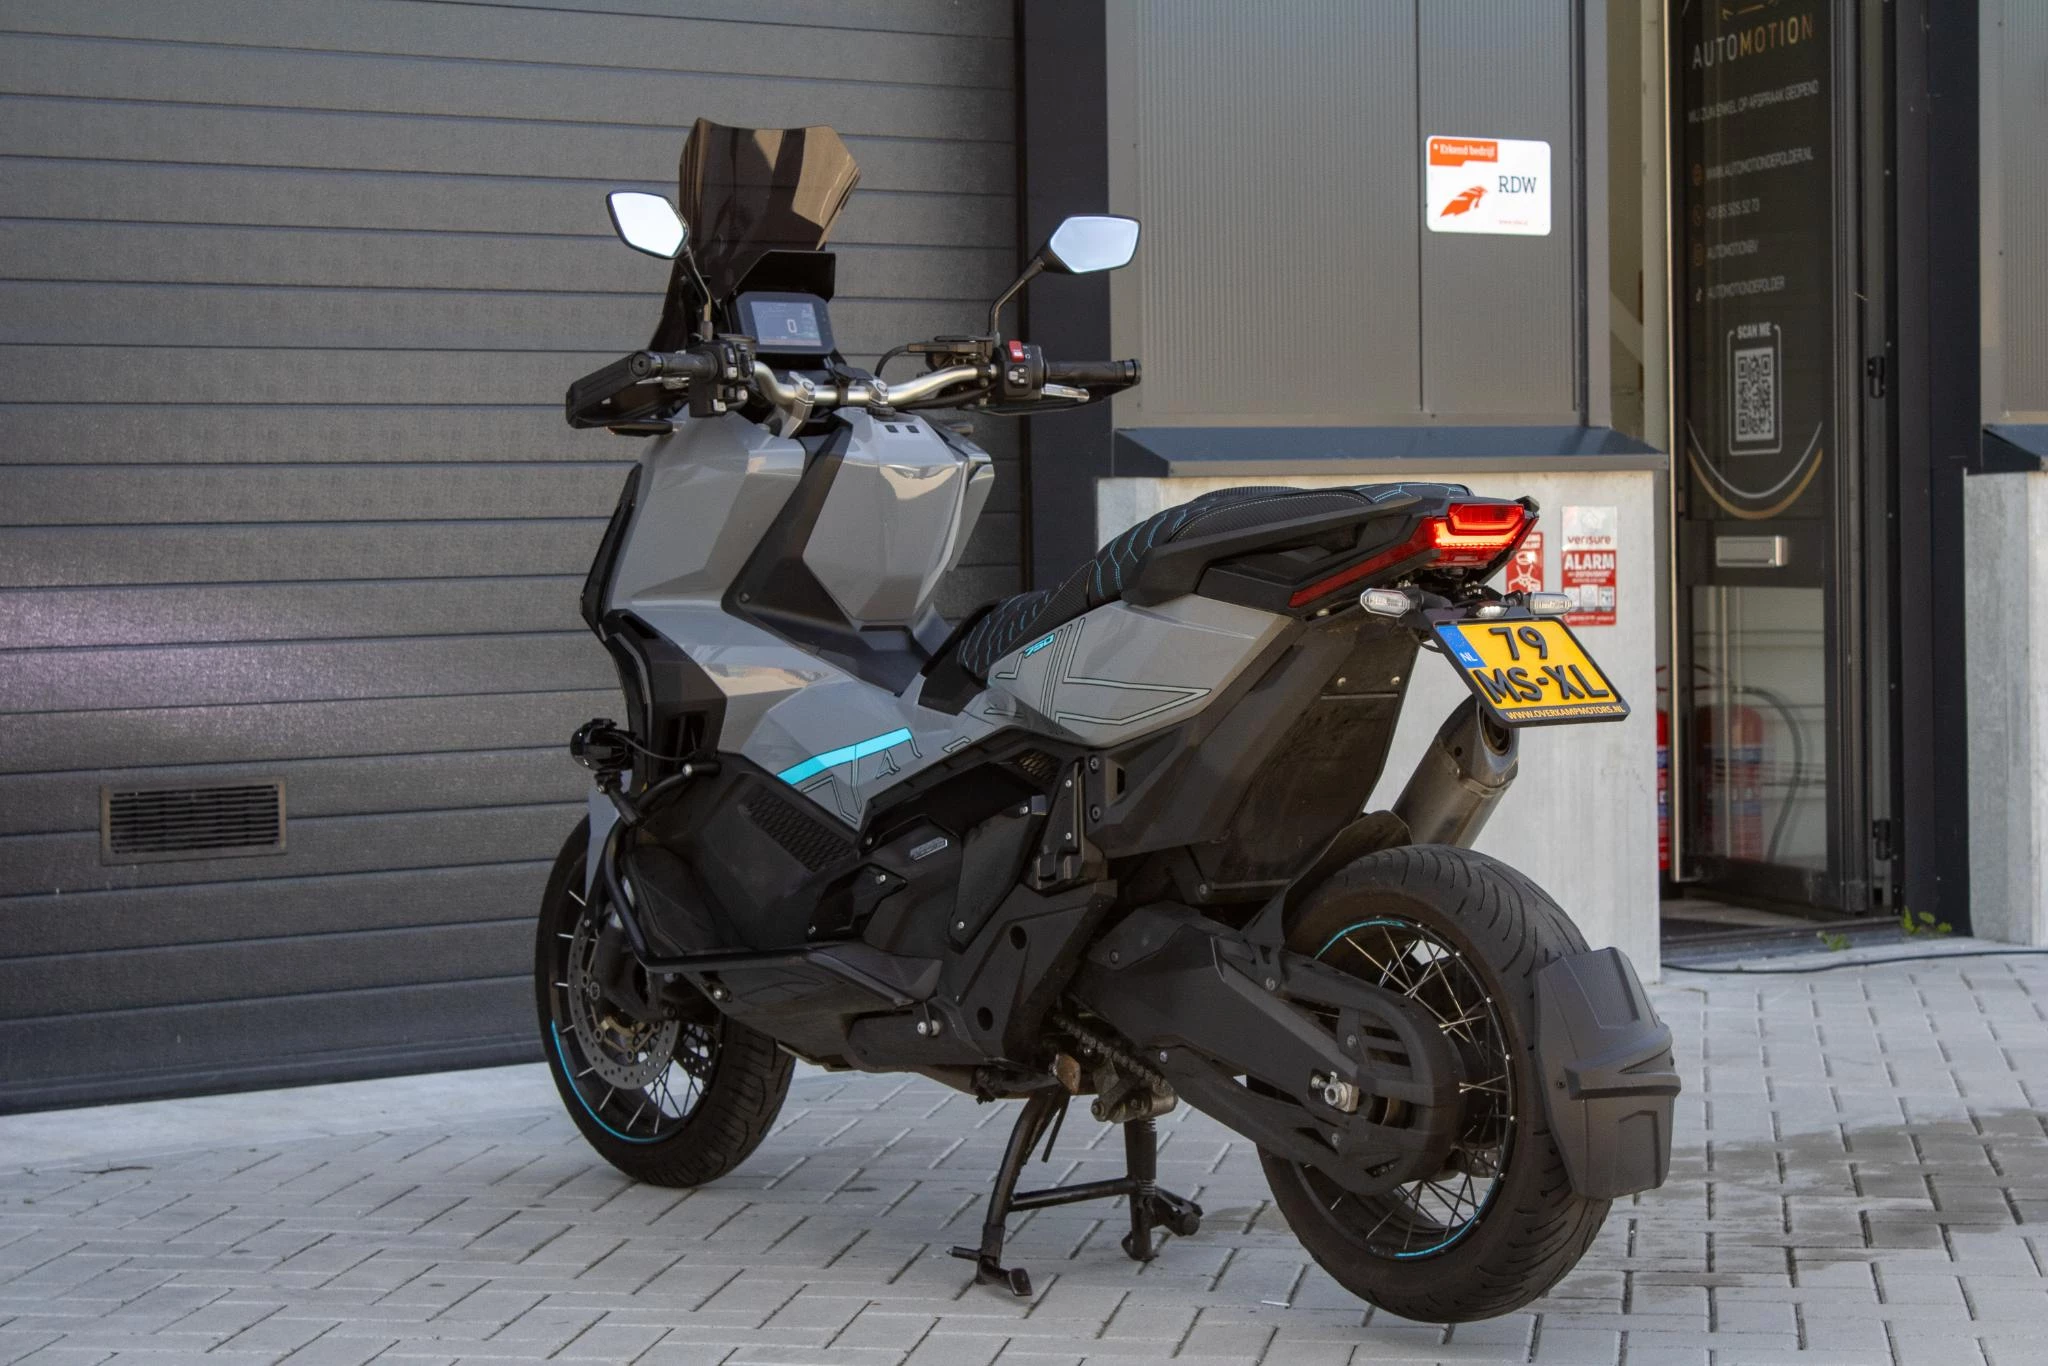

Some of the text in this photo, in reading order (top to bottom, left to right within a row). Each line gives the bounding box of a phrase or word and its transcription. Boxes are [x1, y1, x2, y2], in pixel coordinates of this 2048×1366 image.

[1692, 13, 1813, 70] AUTOMOTION
[1498, 175, 1537, 194] RDW
[1737, 321, 1772, 340] SCAN ME
[1567, 535, 1612, 545] verisure
[1564, 553, 1615, 571] ALARM
[1024, 633, 1055, 658] 750
[1488, 626, 1549, 661] 79
[1459, 651, 1478, 663] NL
[1473, 664, 1610, 704] MS-XL
[1506, 705, 1626, 720] WWW.OVERKAMPMOTORS.NL
